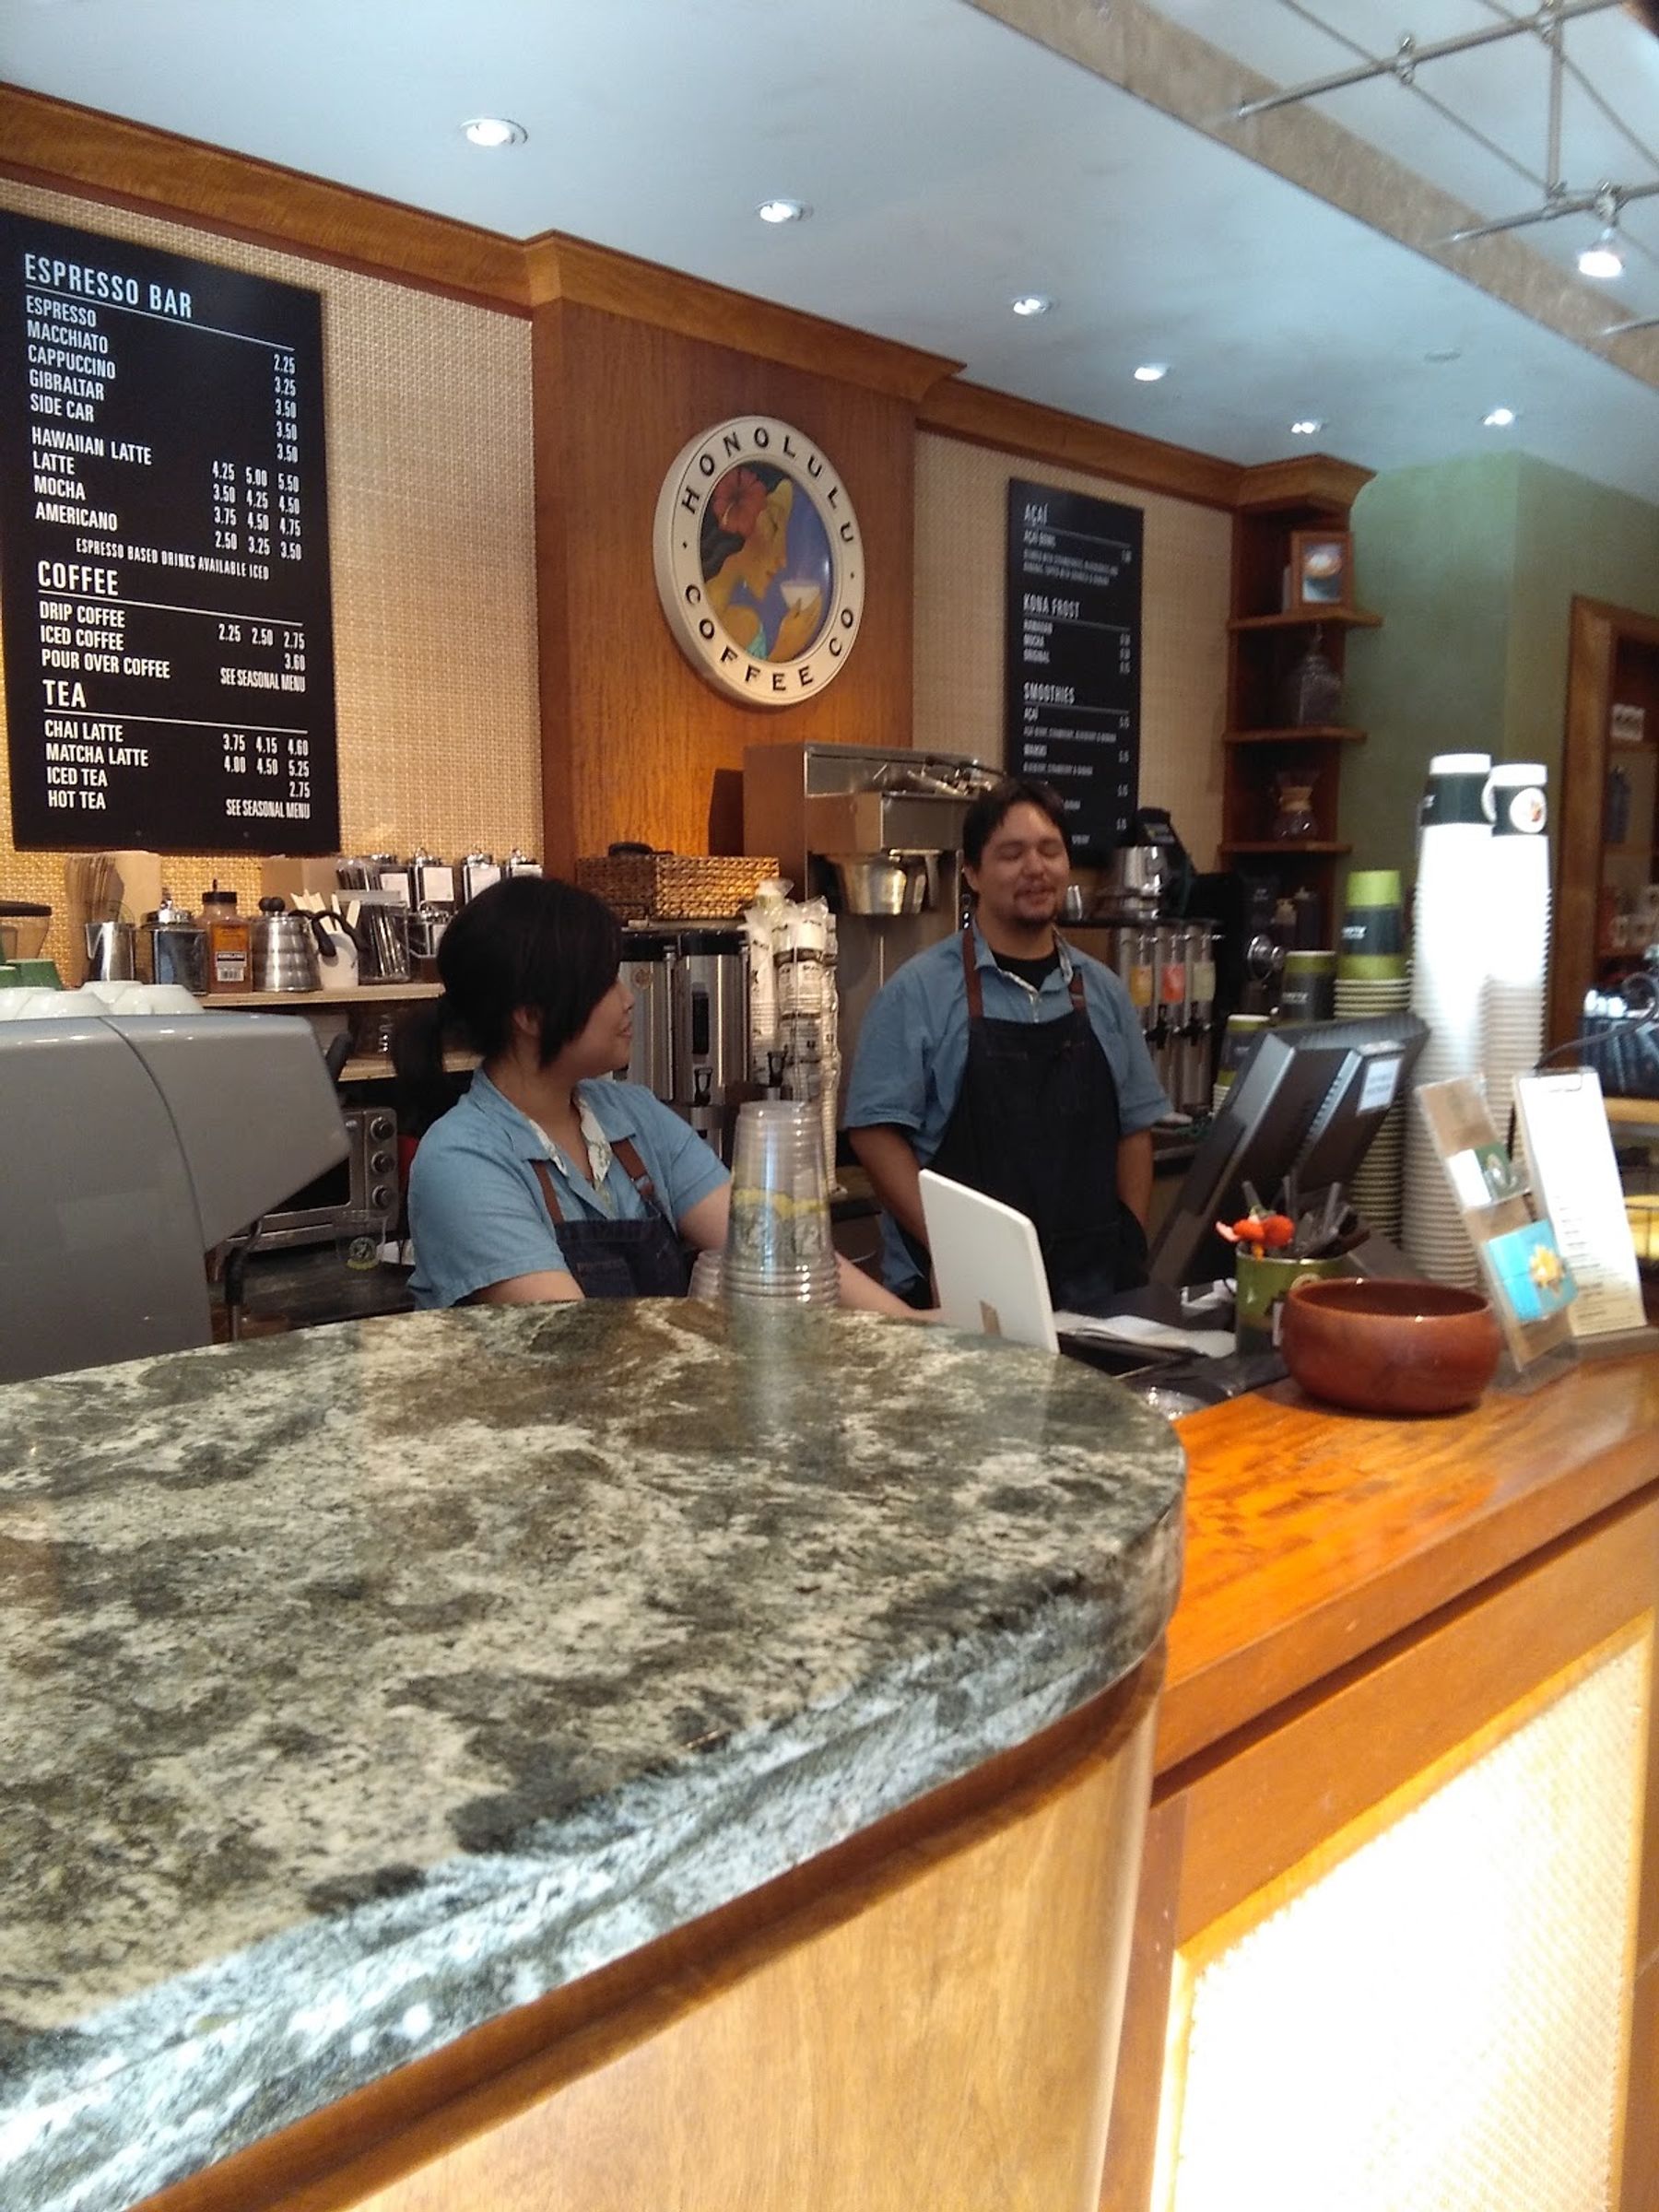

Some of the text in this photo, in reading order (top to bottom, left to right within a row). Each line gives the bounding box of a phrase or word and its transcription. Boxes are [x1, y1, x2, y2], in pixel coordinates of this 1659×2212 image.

[25, 253, 192, 318] ESPRESSO BAR
[26, 295, 96, 327] ESPRESSO
[28, 320, 108, 353] MACCHIATO
[28, 345, 116, 379] CAPPUCCINO
[274, 354, 295, 374] 2.25
[29, 370, 104, 401] GIBRALTAR
[275, 376, 296, 396] 3.25
[30, 393, 94, 422] SIDE CAR
[276, 398, 296, 418] 3.50
[276, 421, 297, 441] 3.50
[31, 427, 151, 465] HAWAIIAN LATTE
[277, 443, 298, 463] 3.50
[33, 451, 75, 475] LATTE
[212, 461, 299, 493] 4.25 5.00 5.50
[34, 476, 86, 500] MOCHA
[213, 484, 300, 514] 3.50 4.25 4.50
[682, 427, 853, 544] HONOLULU
[35, 501, 117, 531] AMERICANO
[214, 507, 300, 537] 3.75 4.50 4.75
[76, 538, 269, 581] ESPRESSO BASED DRINKS AVAILABLE ICED
[215, 531, 301, 561] 2.50 3.25 3.50
[37, 560, 118, 595] COFFEE
[39, 601, 125, 628] DRIP COFFEE
[41, 626, 124, 651] ICED COFFEE
[218, 623, 304, 651] 2.25 2.50 2.75
[685, 584, 853, 691] COFFEE CO
[41, 649, 171, 679] POUR OVER COFFEE
[42, 678, 87, 708] TEA
[220, 667, 305, 692] SEE SEASONAL MENU
[45, 720, 124, 743] CHAI LATTE
[223, 734, 245, 752] 3.75
[256, 736, 277, 755] 4.15
[46, 743, 148, 767] MATCHA LATTE
[224, 756, 310, 778] 4.00 4.50 5.25
[47, 766, 108, 787] ICED TEA
[289, 781, 311, 799] 2.75
[48, 790, 106, 810] HOT TEA
[226, 798, 311, 820] SEE SEASONAL MENU
